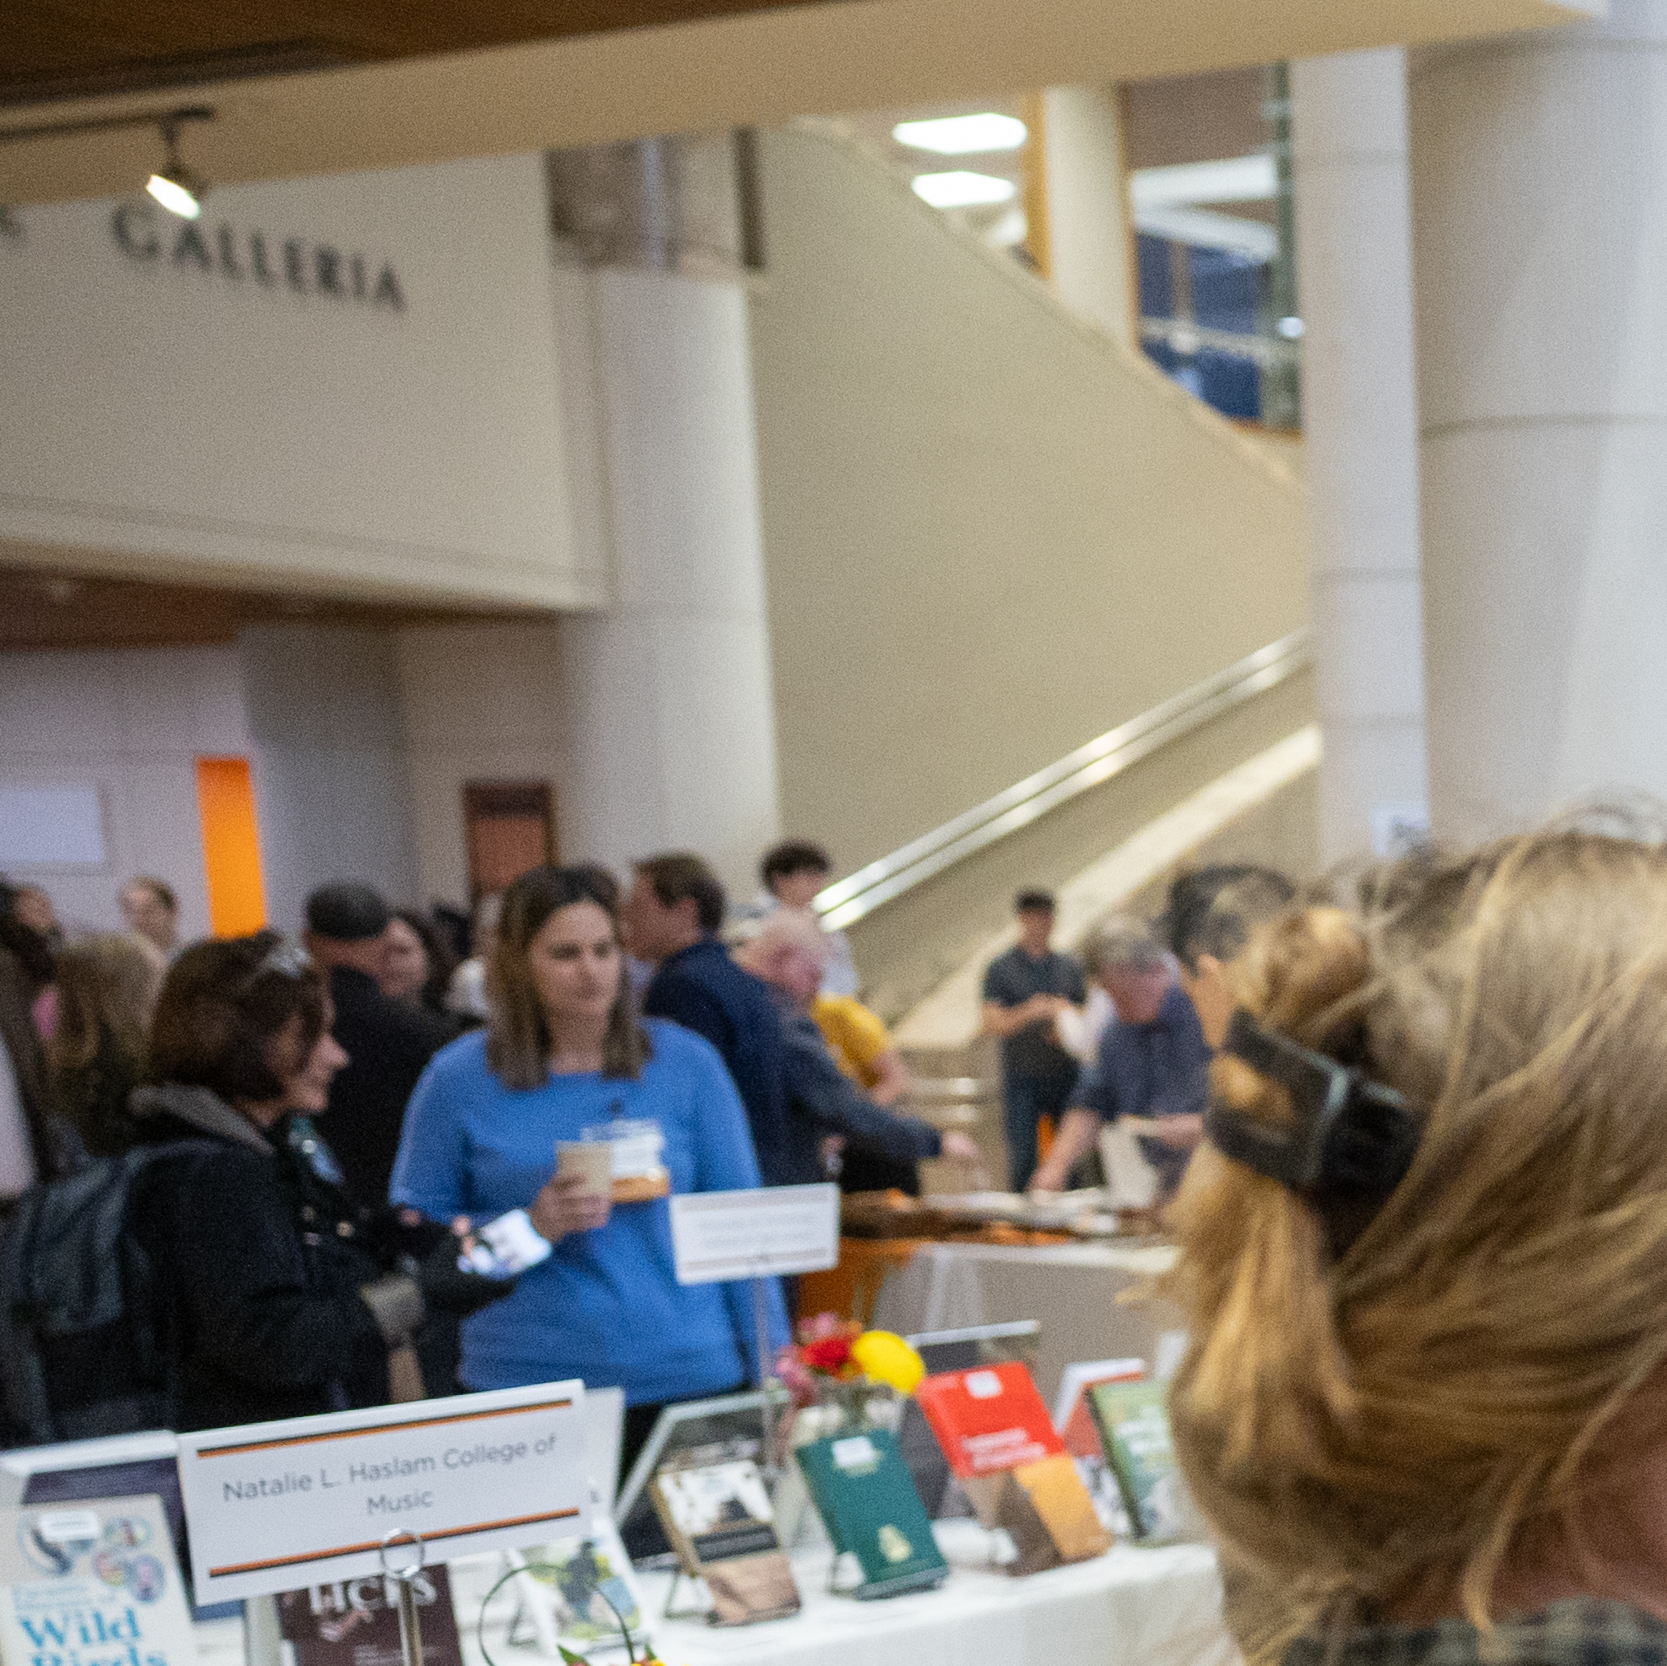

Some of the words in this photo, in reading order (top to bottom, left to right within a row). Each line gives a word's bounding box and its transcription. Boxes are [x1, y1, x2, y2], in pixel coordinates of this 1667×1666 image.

[110, 203, 406, 312] GALLERIA
[222, 1469, 313, 1502] Natalie
[319, 1467, 342, 1489] L.
[348, 1454, 437, 1484] Haslam
[442, 1440, 527, 1471] College
[533, 1432, 557, 1455] of
[366, 1488, 435, 1516] Music
[20, 1606, 142, 1648] Wild
